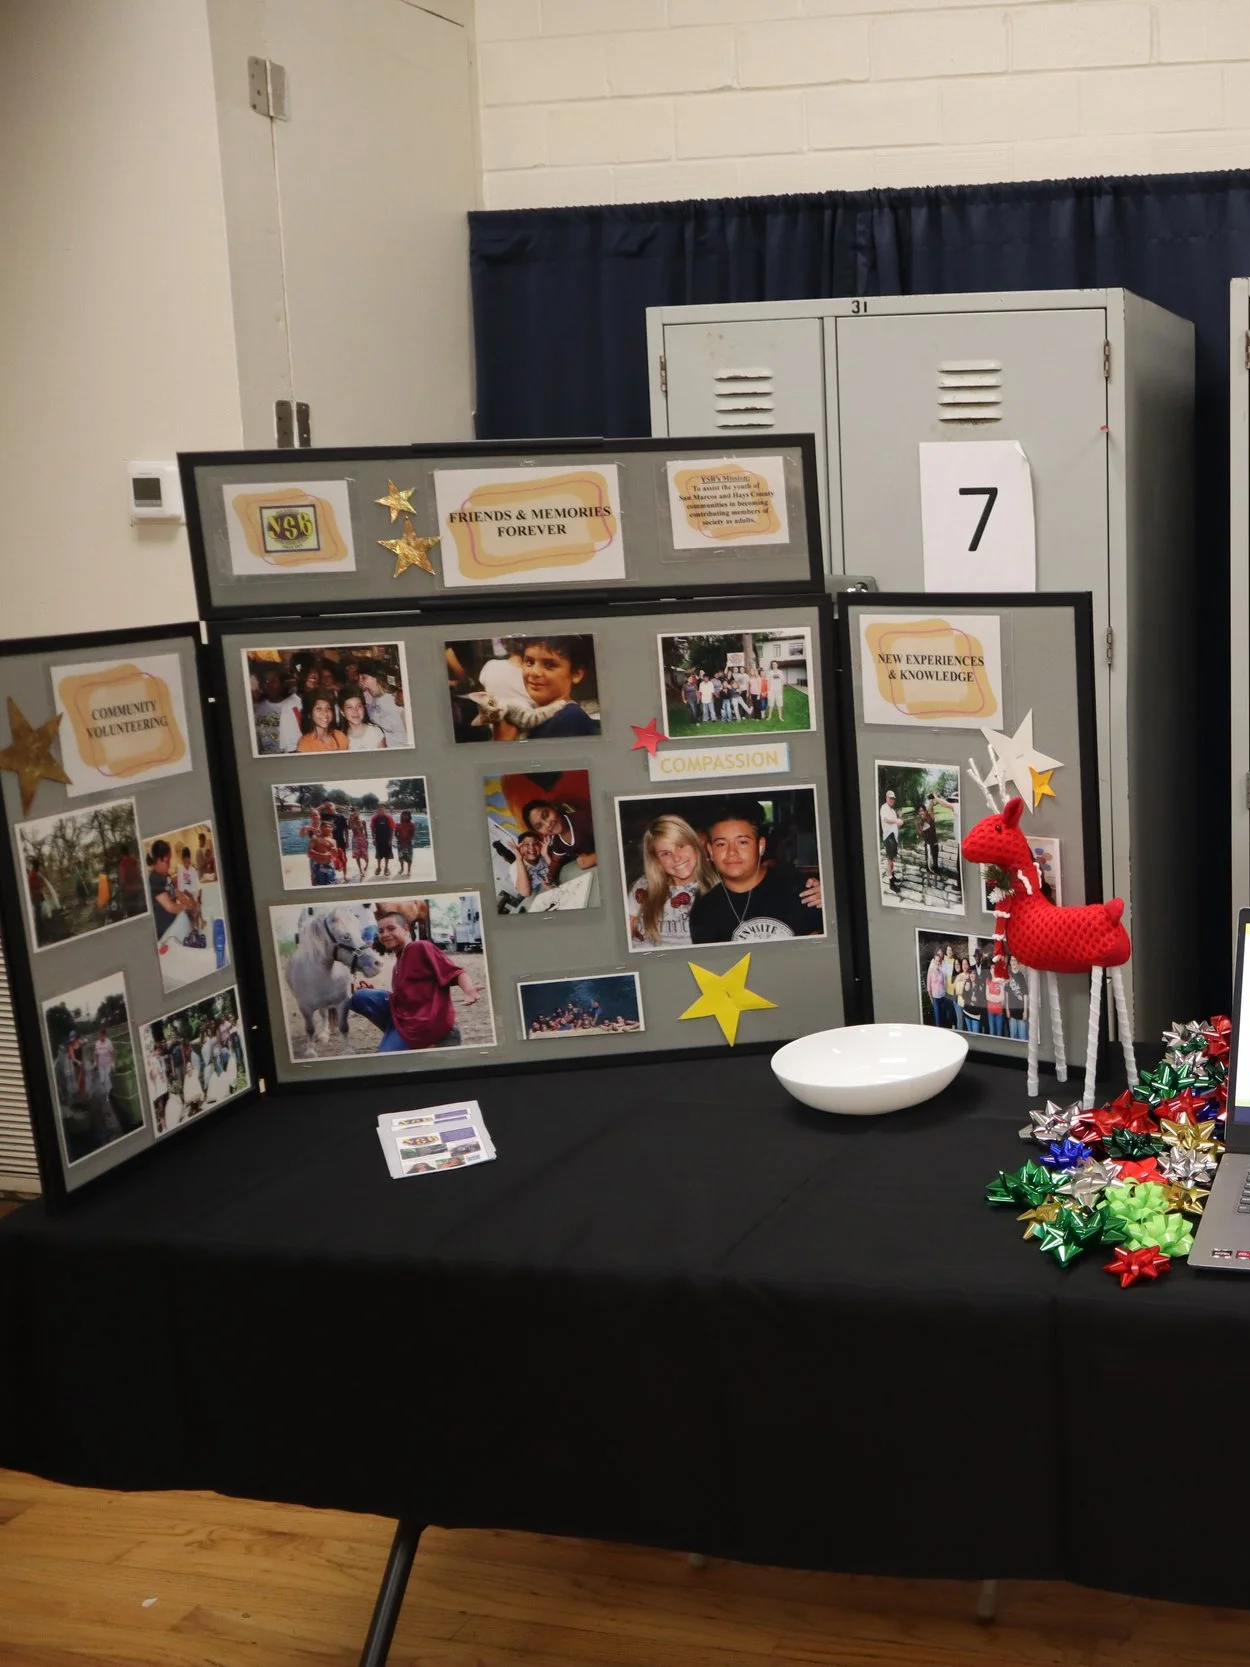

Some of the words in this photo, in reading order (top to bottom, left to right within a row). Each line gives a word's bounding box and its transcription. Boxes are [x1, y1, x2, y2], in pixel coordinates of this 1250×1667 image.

[851, 300, 867, 314] 31
[733, 483, 751, 491] youth
[686, 501, 728, 510] communities
[737, 499, 769, 508] becoming
[449, 510, 512, 523] FRIENDS
[515, 509, 527, 521] &
[531, 506, 612, 520] MEMORIES
[689, 509, 730, 519] contributing
[959, 487, 998, 551] 7
[497, 523, 567, 538] FOREVER
[878, 653, 902, 665] NEW
[905, 654, 985, 667] EXPERIENCES
[888, 669, 897, 680] &
[900, 670, 975, 682] KNOWLEDGE
[91, 700, 157, 721] COMMUNITY
[86, 715, 168, 739] VOLUNTEERING
[660, 751, 778, 774] COMPASSION
